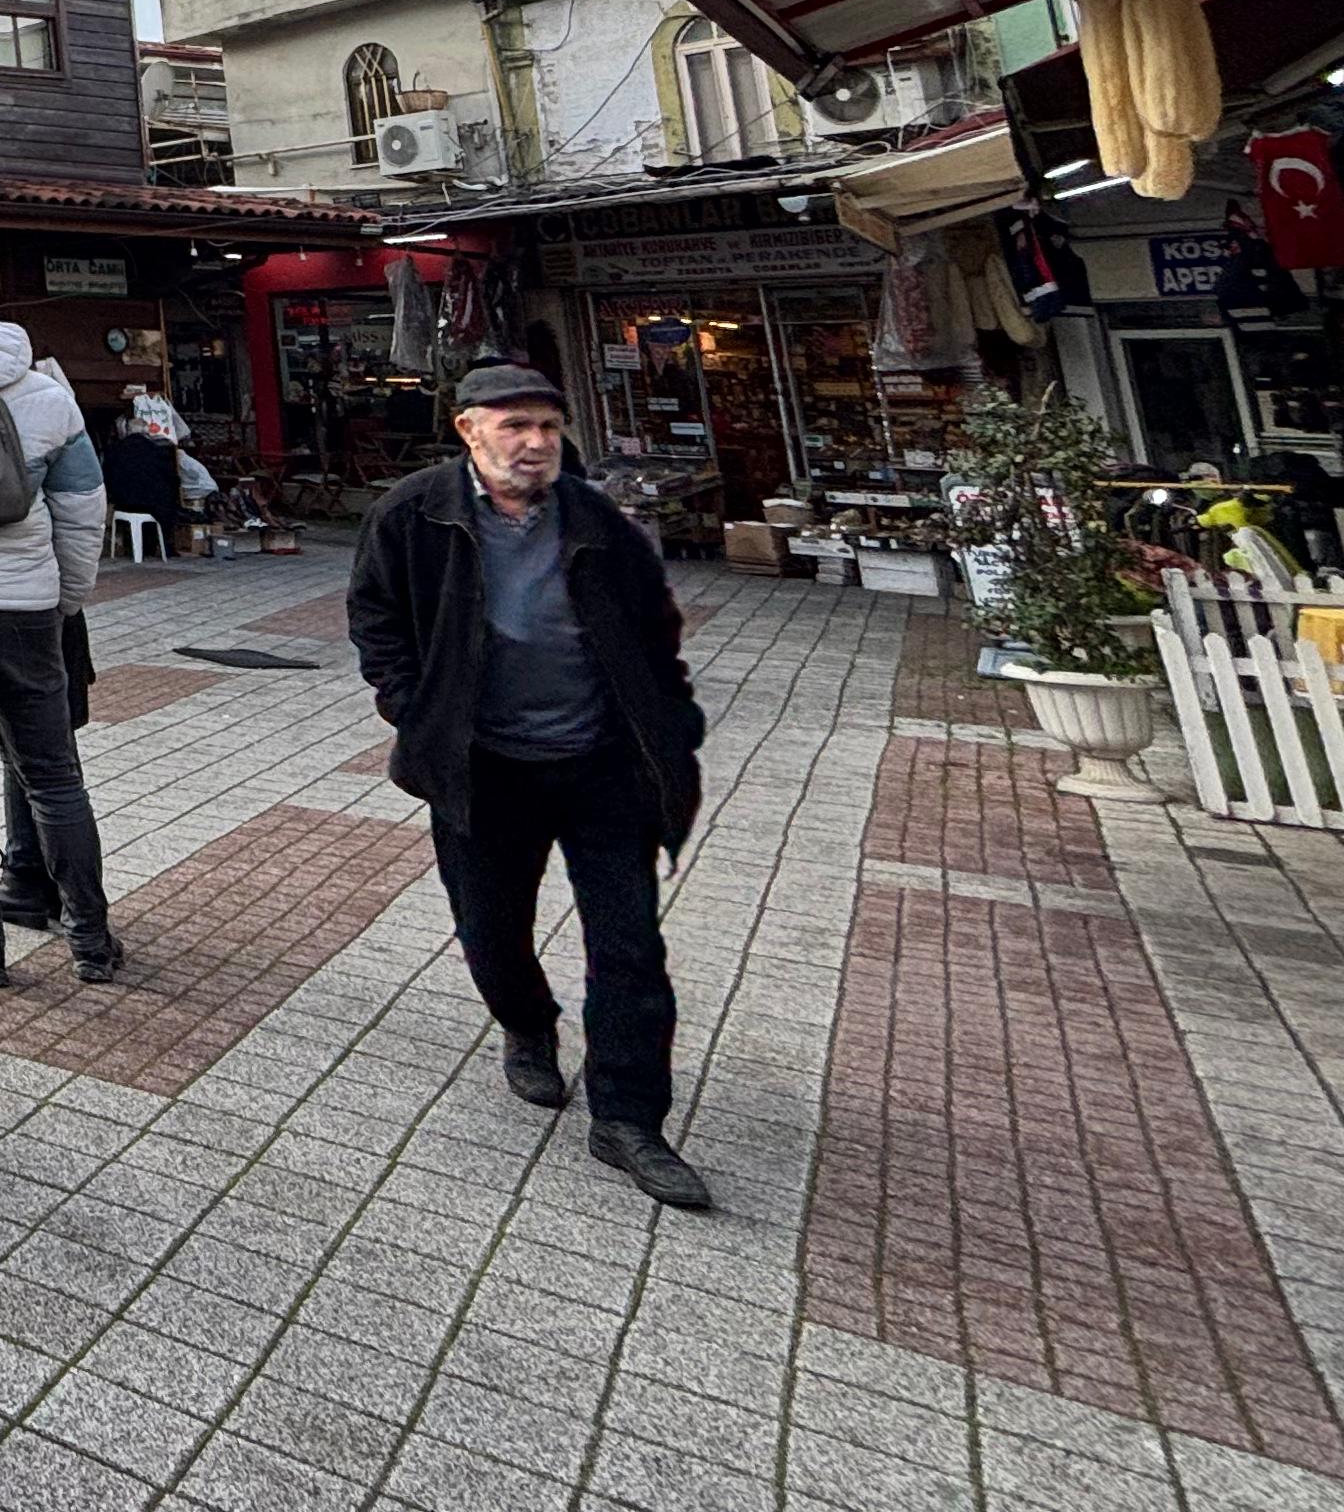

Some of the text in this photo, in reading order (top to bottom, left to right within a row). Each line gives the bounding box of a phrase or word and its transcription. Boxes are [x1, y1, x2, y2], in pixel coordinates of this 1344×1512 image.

[638, 253, 714, 268] TOPTAN
[732, 246, 861, 263] PERAKENDE
[1161, 238, 1231, 261] KÖŞ
[46, 260, 81, 273] ORTA
